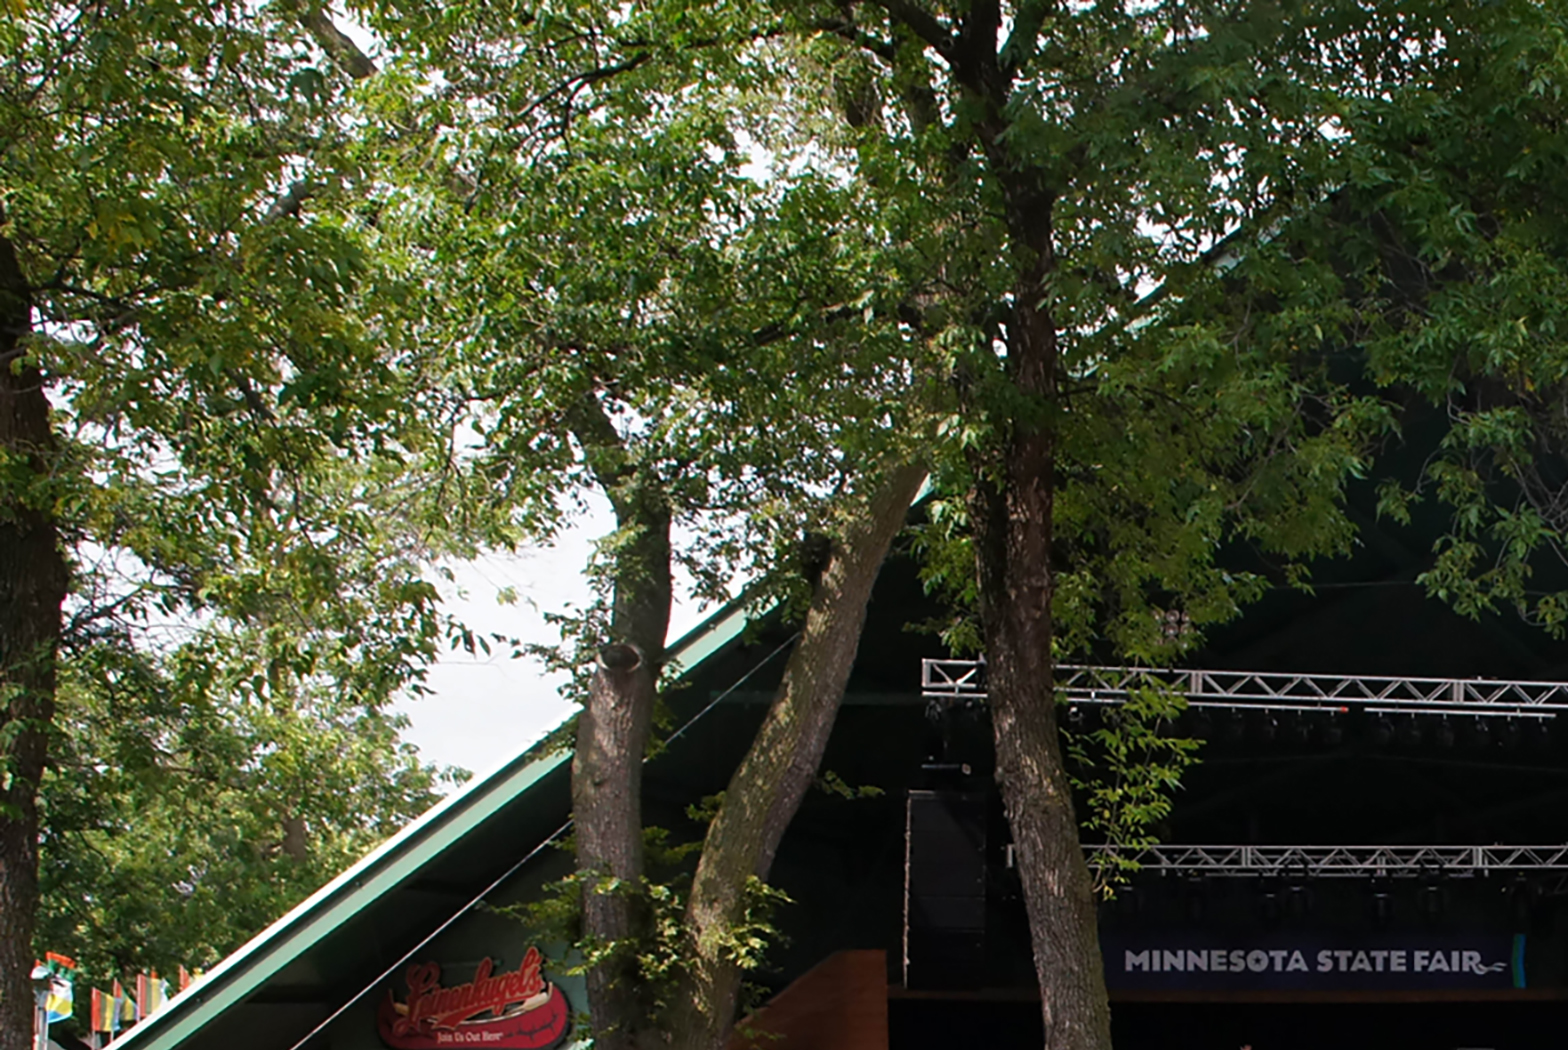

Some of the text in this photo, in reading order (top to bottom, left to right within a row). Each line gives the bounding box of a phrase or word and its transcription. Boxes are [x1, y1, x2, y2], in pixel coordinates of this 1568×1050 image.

[1125, 950, 1490, 975] MINNESOTA STATE FAIR
